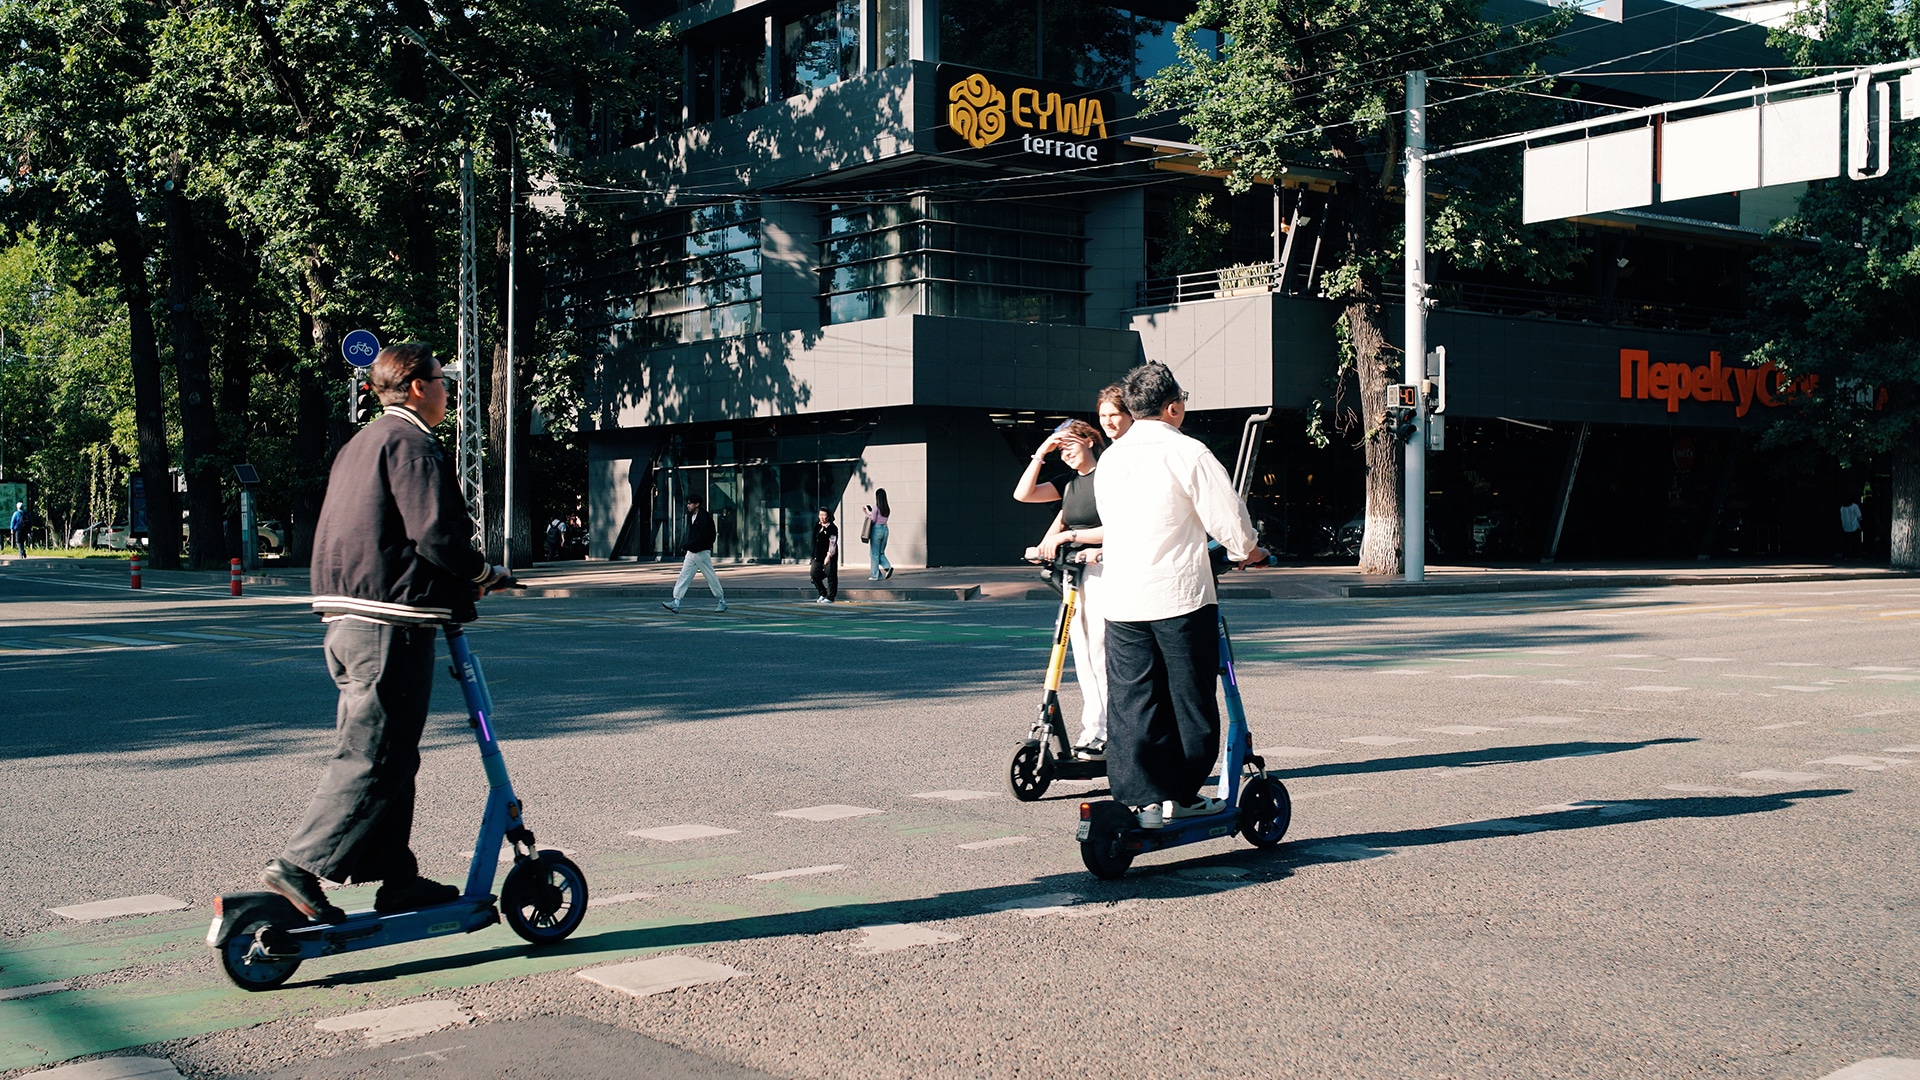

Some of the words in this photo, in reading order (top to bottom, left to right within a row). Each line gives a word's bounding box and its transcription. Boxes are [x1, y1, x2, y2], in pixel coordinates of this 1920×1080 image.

[1012, 87, 1108, 140] EYWA
[1022, 133, 1098, 161] terrace
[1399, 388, 1414, 405] 40
[462, 661, 477, 683] JET
